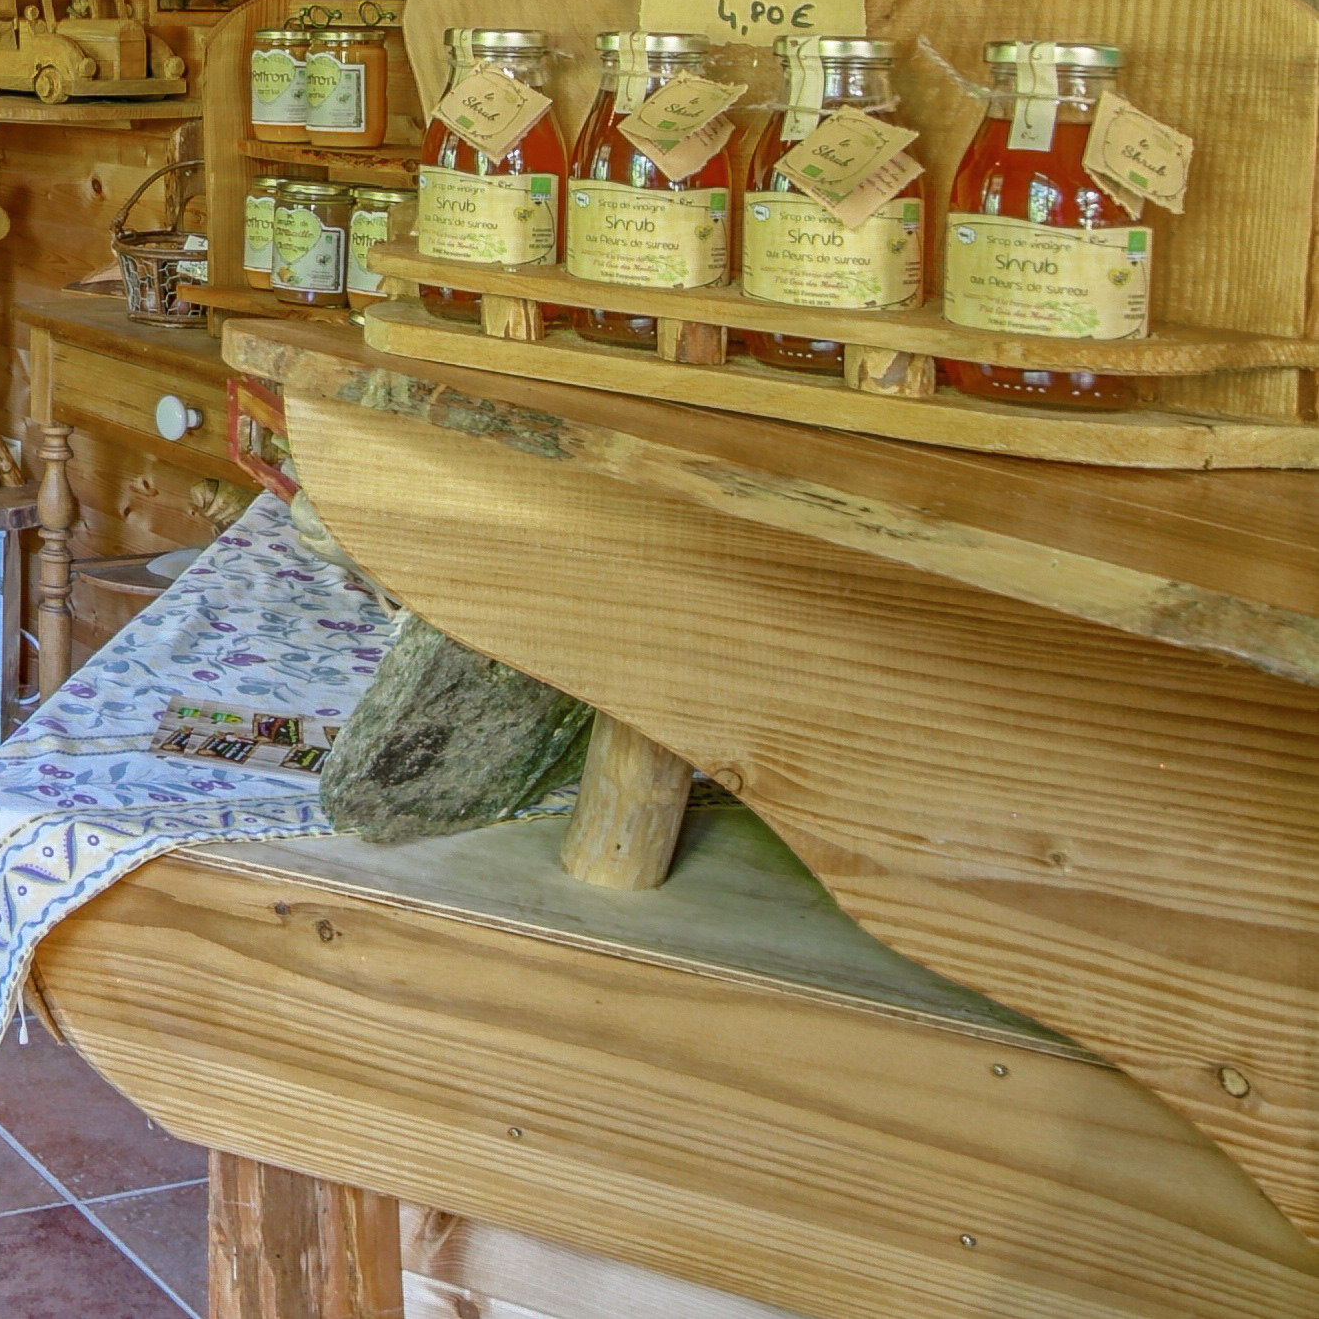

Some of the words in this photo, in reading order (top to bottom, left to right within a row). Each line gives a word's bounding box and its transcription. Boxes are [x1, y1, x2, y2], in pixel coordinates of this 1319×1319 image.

[460, 95, 503, 124] Shrub
[810, 142, 851, 169] Shrub
[1122, 147, 1167, 178] Shrub
[436, 196, 476, 213] Shrub
[455, 218, 465, 226] de
[467, 220, 498, 230] sureau
[605, 215, 655, 233] Shrub
[630, 239, 643, 247] de
[646, 241, 680, 251] sureau
[788, 229, 844, 247] Shrub
[817, 254, 830, 263] de
[834, 255, 871, 266] sureau
[996, 254, 1058, 275] Shrub
[1026, 281, 1042, 292] de
[1046, 284, 1089, 296] sureau
